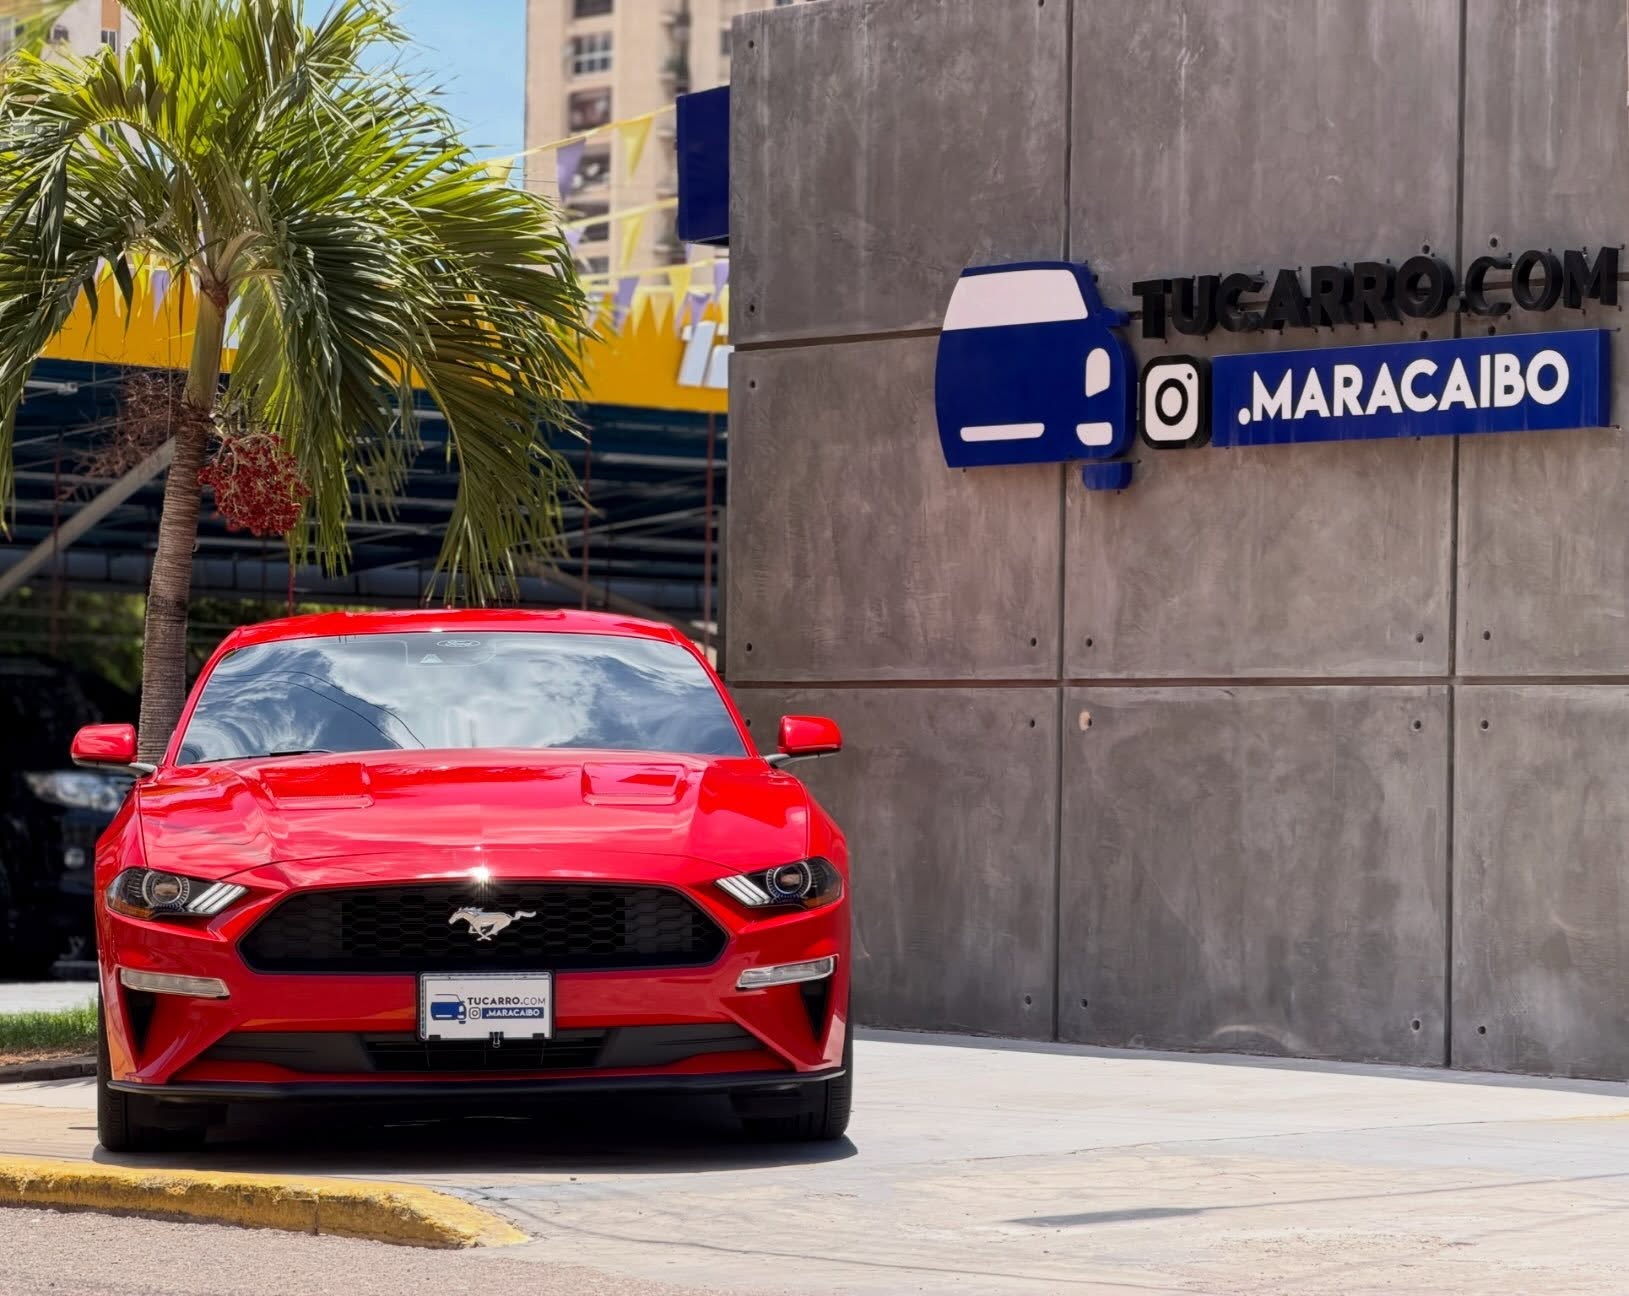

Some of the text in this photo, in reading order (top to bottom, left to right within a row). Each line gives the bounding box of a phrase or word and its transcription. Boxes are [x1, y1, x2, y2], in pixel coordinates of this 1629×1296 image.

[1132, 247, 1619, 339] TUCARRO.COM
[1238, 350, 1569, 426] .MARACAIBO
[467, 997, 546, 1005] TUCARRO.COM
[486, 1009, 540, 1017] .MARACAIBO
